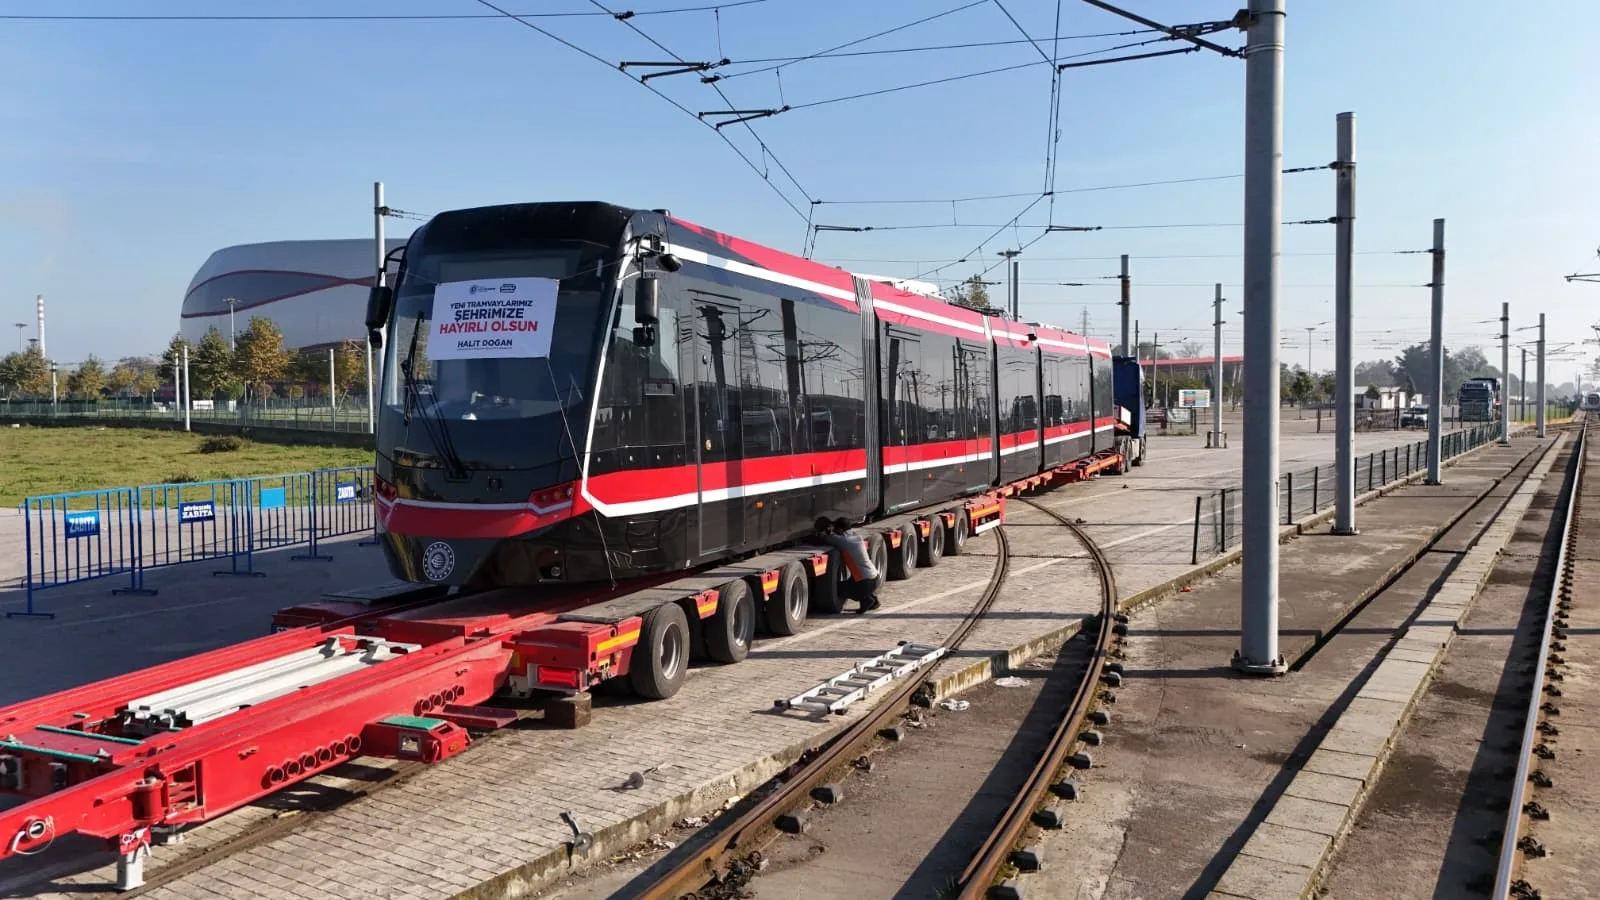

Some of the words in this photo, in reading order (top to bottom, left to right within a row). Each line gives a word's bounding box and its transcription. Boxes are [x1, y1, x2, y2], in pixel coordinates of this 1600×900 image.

[467, 300, 533, 308] TRAMVAYLARIMIZ
[439, 321, 488, 334] HAYIRLI
[491, 321, 538, 332] OLSUN
